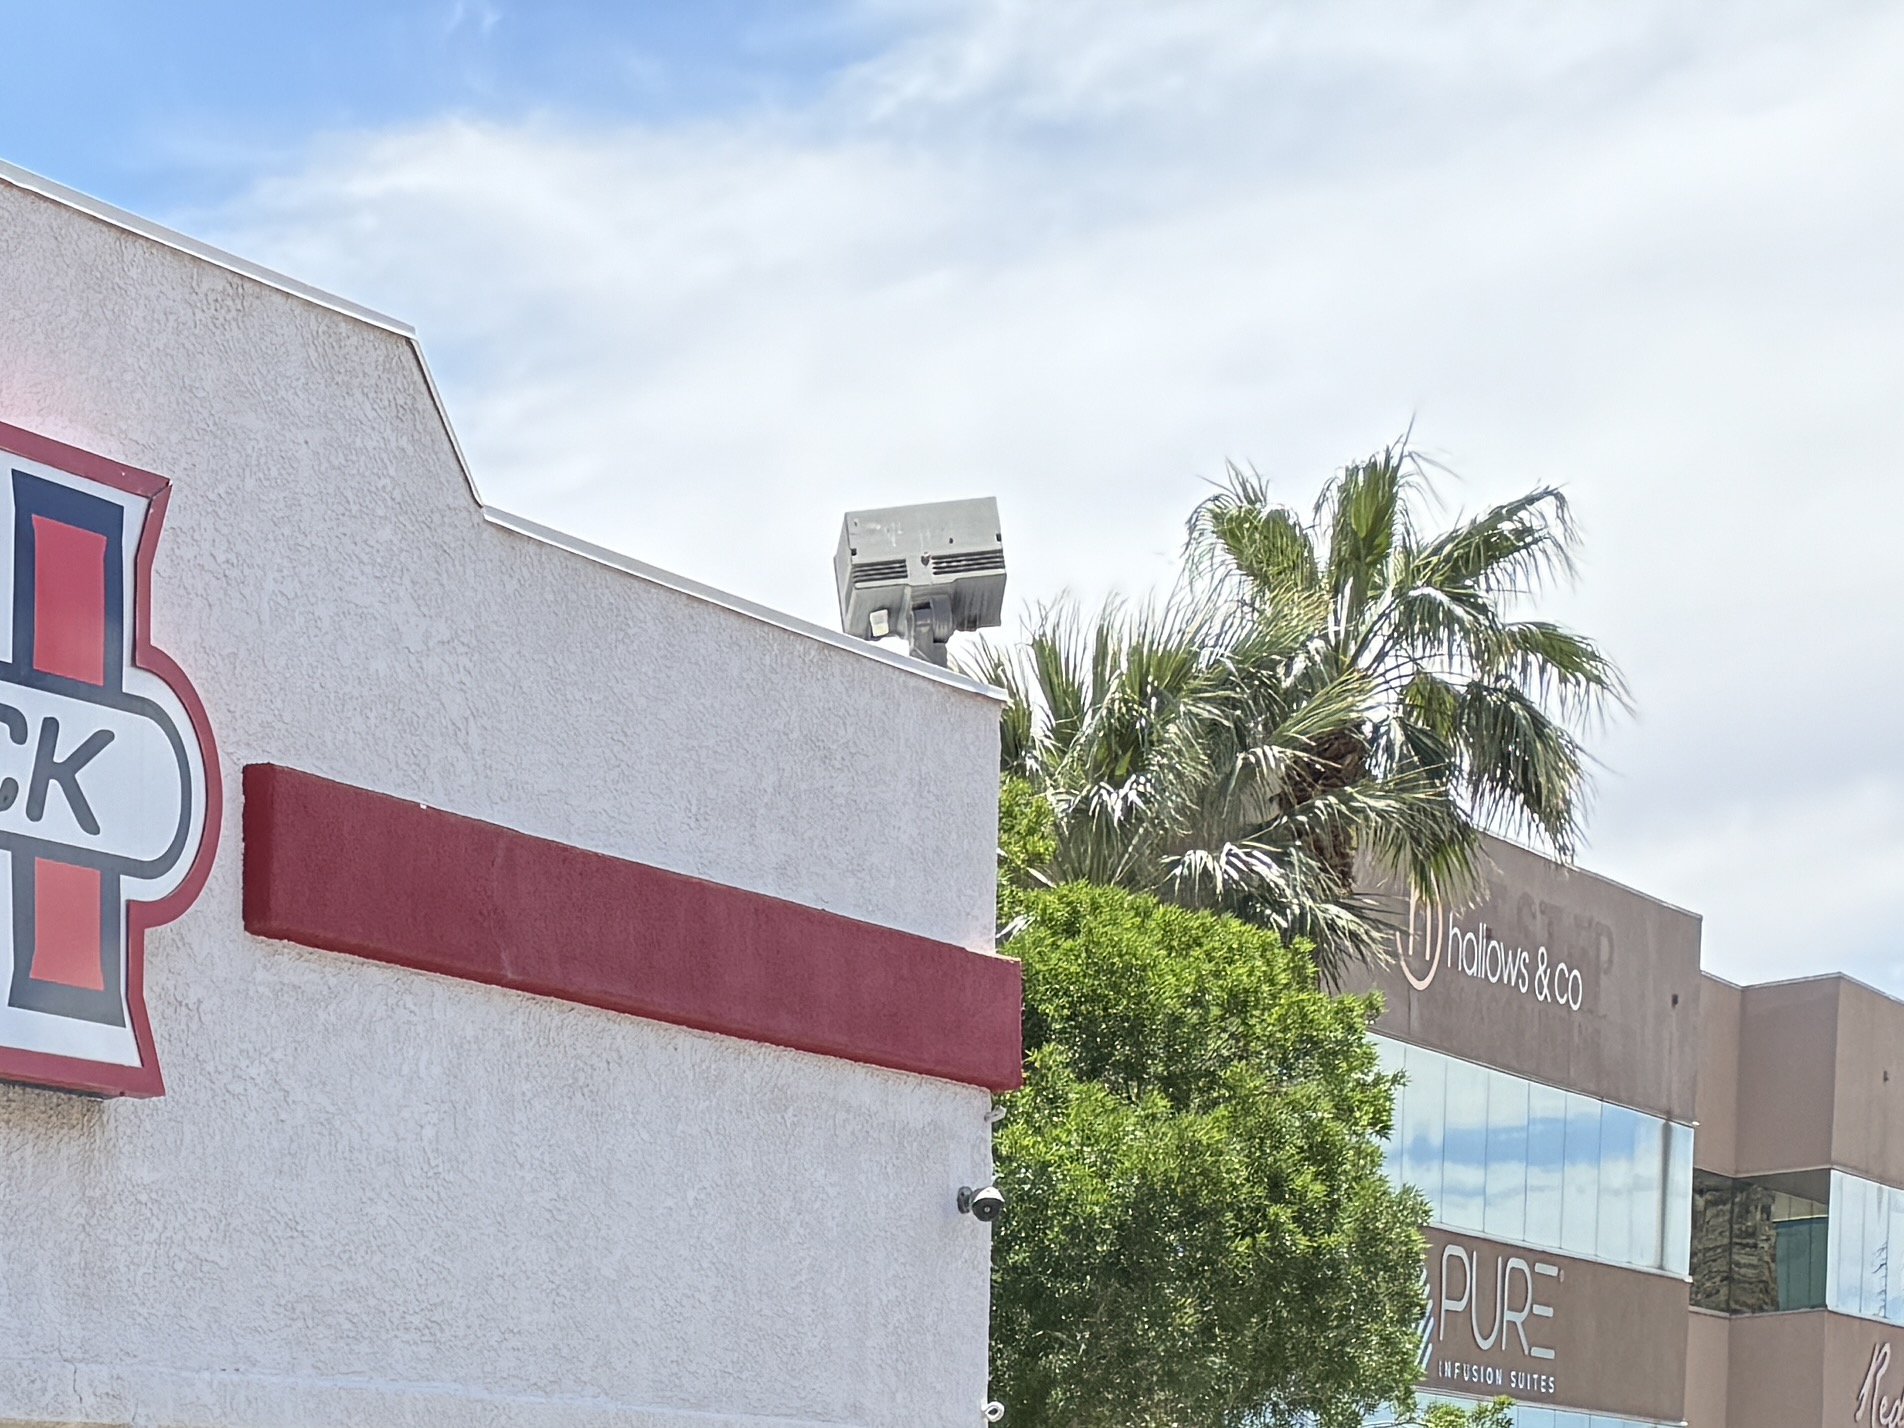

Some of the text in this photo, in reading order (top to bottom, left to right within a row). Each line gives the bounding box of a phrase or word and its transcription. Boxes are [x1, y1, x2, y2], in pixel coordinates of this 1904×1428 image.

[1448, 911, 1529, 994] hallows
[1535, 946, 1552, 1003] &
[1554, 962, 1583, 1011] co
[1439, 1244, 1559, 1359] PURE
[1439, 1360, 1555, 1393] INFUSION SUITES
